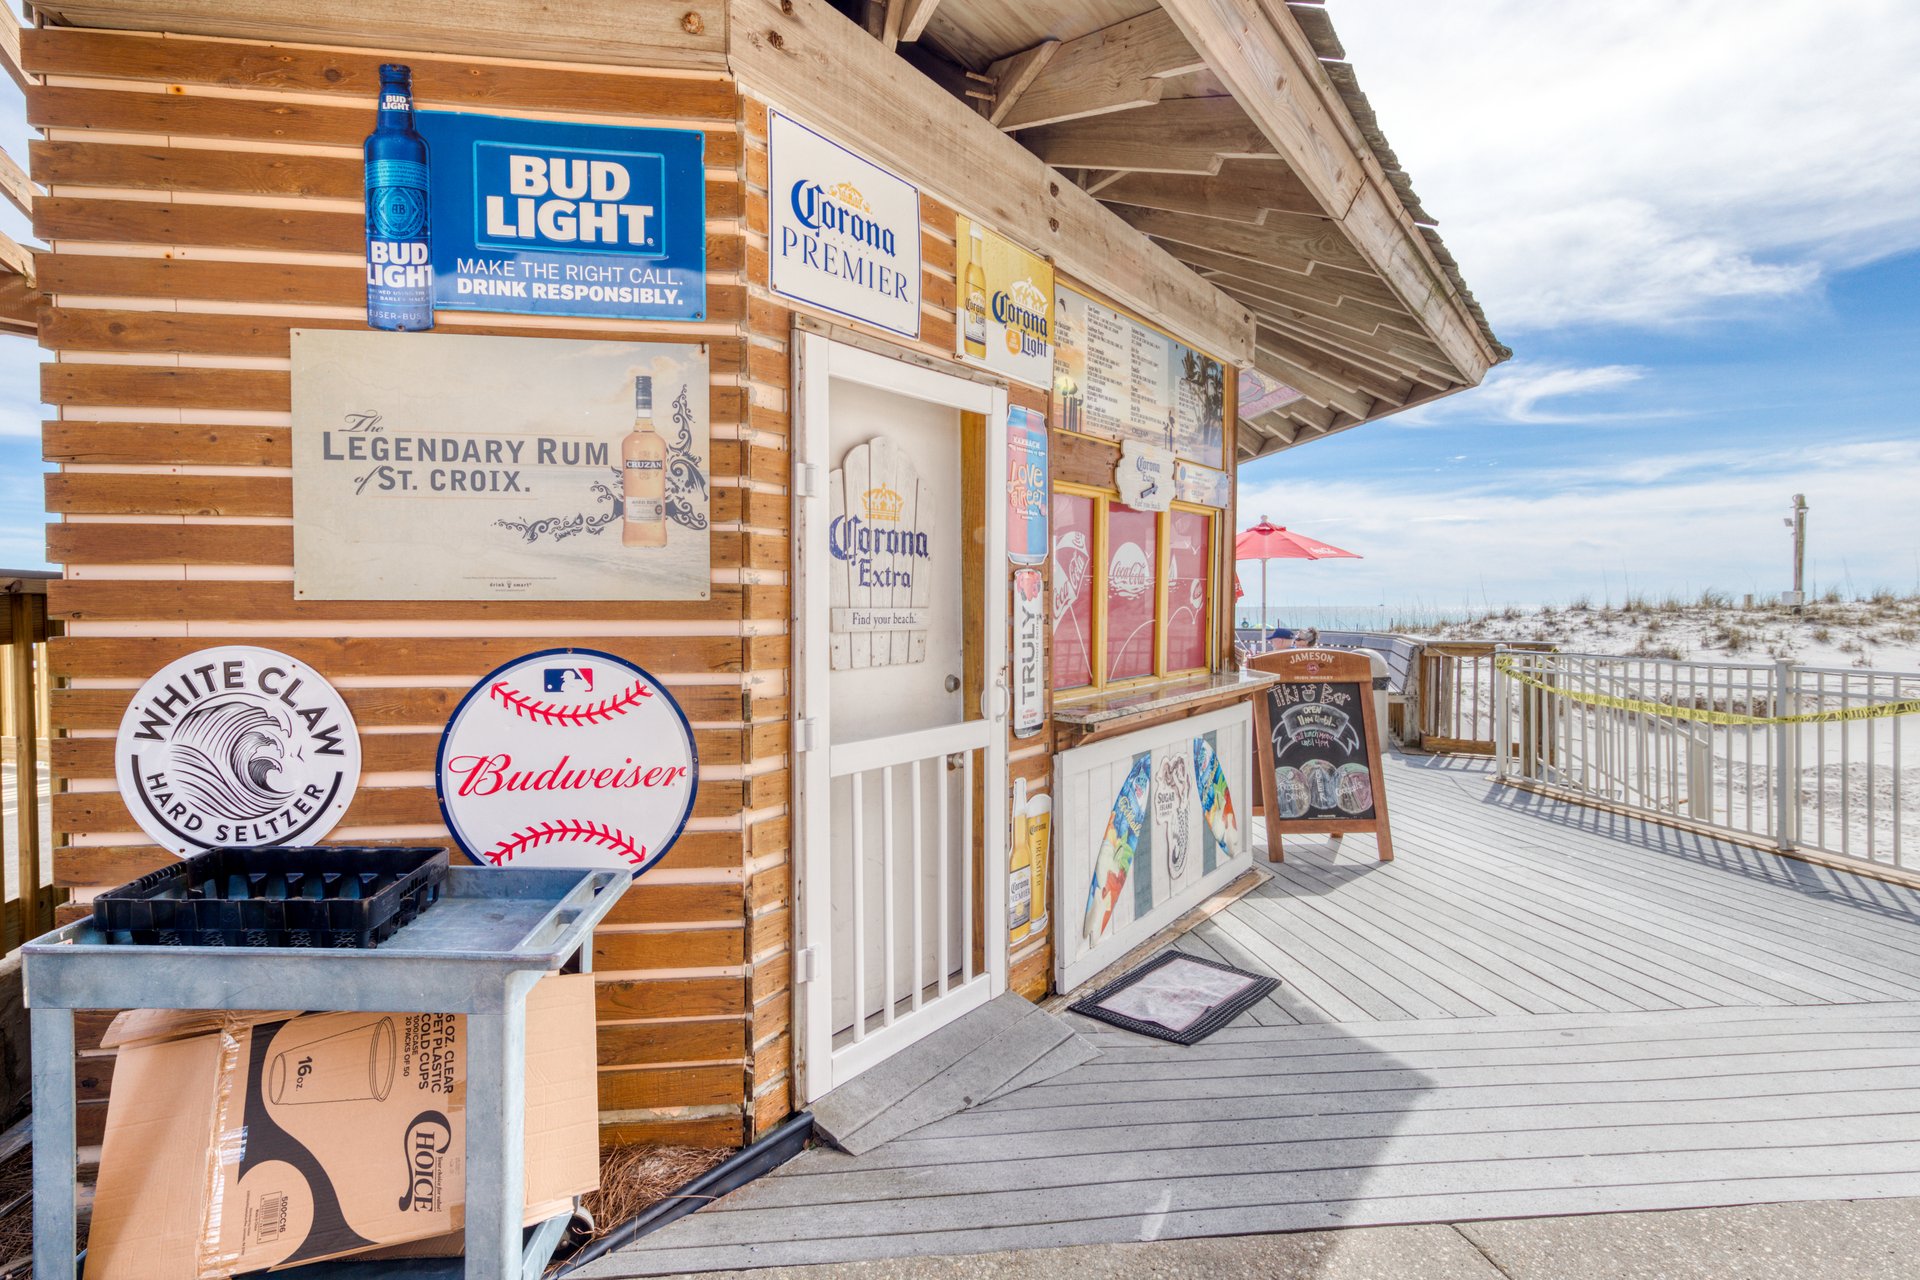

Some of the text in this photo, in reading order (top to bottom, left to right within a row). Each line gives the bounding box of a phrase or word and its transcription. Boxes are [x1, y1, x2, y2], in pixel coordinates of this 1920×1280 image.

[382, 102, 410, 112] LIGHT
[385, 95, 407, 104] BUD
[509, 155, 631, 201] BUD
[790, 179, 896, 257] Corona
[370, 241, 428, 265] BUD
[782, 225, 910, 304] PREMIER
[367, 262, 433, 288] LIGHT
[457, 257, 683, 286] MAKE THE RIGHT CALL.
[457, 278, 684, 305] DRINK RESPONSIBLY.
[991, 290, 1048, 337] Corona
[1020, 329, 1048, 358] Light
[338, 409, 384, 434] The
[323, 431, 609, 466] LEGENDARY RUM
[626, 461, 662, 469] CRUZAN
[1136, 456, 1161, 473] Corona
[354, 465, 531, 496] of ST. CROIX.
[829, 514, 930, 566] Corona
[858, 558, 911, 588] Extra
[852, 612, 871, 625] Find
[873, 614, 891, 629] your
[1022, 605, 1036, 705] TRULY
[1290, 652, 1335, 664] JAMESON
[133, 661, 345, 756] WHITE CLAW
[1302, 705, 1322, 714] OPEN
[449, 754, 687, 797] Budweiser
[1316, 769, 1328, 802] BEER
[147, 773, 324, 842] HARD SELTZER
[1157, 792, 1175, 804] SUGAR
[1029, 823, 1047, 836] Corona
[1011, 879, 1029, 894] Corona
[405, 1016, 412, 1026] 20
[412, 1015, 420, 1056] 1000/CASE
[404, 1054, 410, 1065] OF
[419, 1013, 431, 1090] COLD CUPS
[431, 1038, 443, 1093] PLASTIC
[443, 1013, 455, 1094] 6 OZ. CLEAR
[295, 1056, 314, 1092] 16 oz.
[403, 1066, 410, 1077] 50
[399, 1110, 452, 1212] CHOICE
[280, 1196, 288, 1233] 500CC16
